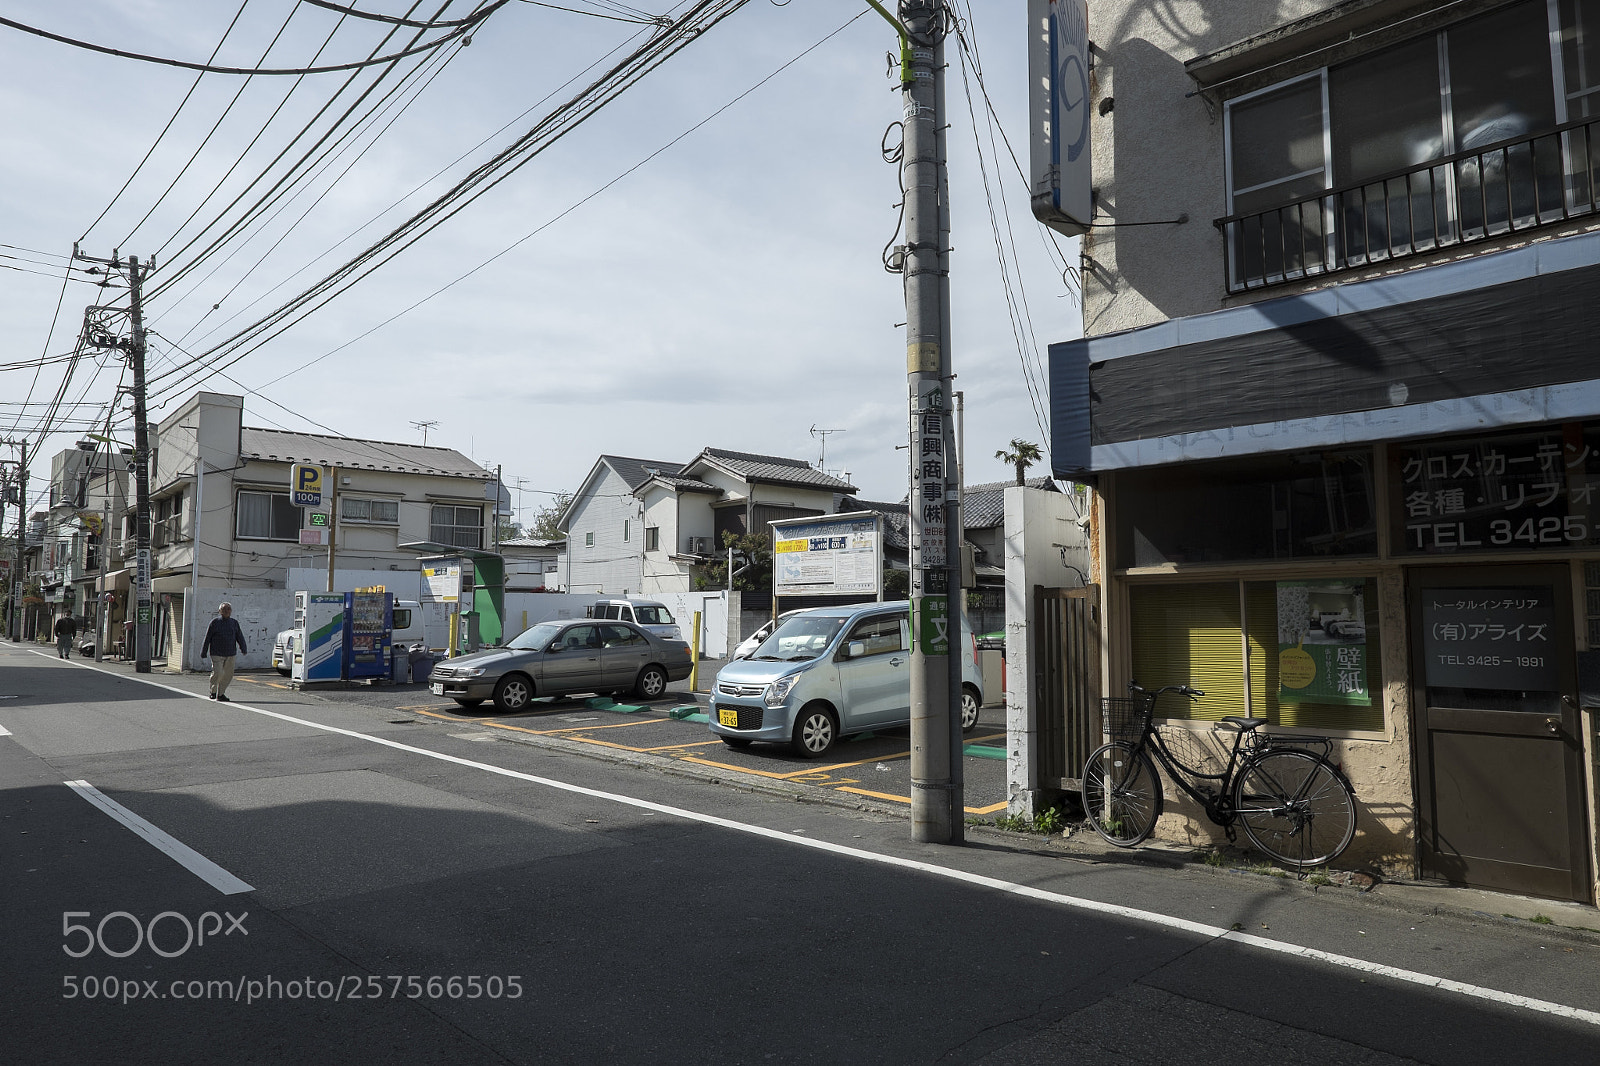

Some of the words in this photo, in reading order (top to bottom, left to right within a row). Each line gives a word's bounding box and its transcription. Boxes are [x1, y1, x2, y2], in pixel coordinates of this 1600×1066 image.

[299, 467, 319, 490] P
[1407, 522, 1482, 548] TEL
[1490, 515, 1600, 545] 3425
[929, 601, 948, 611] 通学
[1432, 599, 1539, 612] トータルインテリア
[1438, 655, 1465, 666] TEL
[1336, 646, 1364, 695] 壁紙
